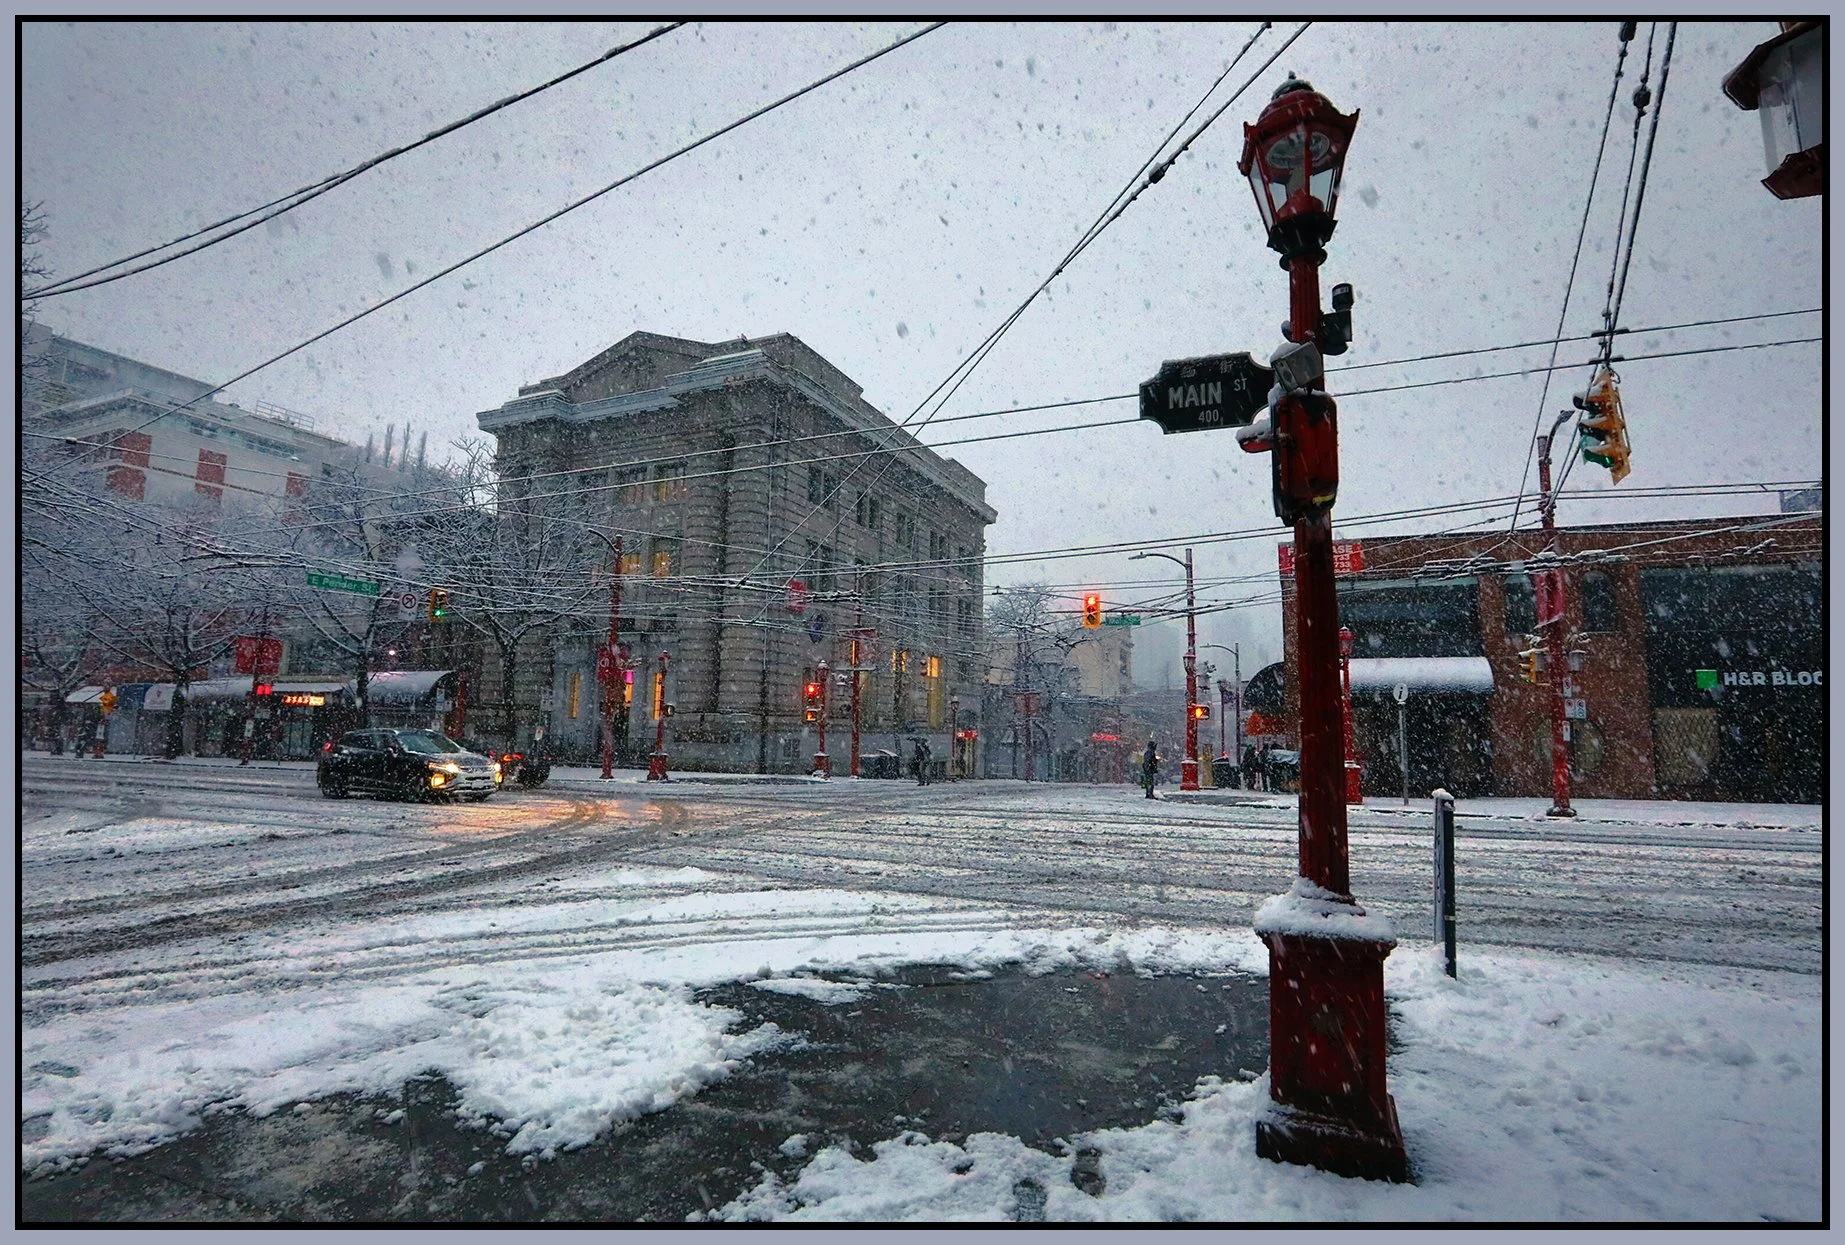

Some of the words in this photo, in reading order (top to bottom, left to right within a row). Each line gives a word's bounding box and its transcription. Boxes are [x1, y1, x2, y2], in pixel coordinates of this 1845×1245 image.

[1168, 381, 1222, 410] MAIN
[1233, 378, 1248, 392] ST
[1198, 409, 1220, 423] 400
[311, 575, 319, 585] E
[322, 578, 357, 590] Pender
[1723, 671, 1767, 686] H&R
